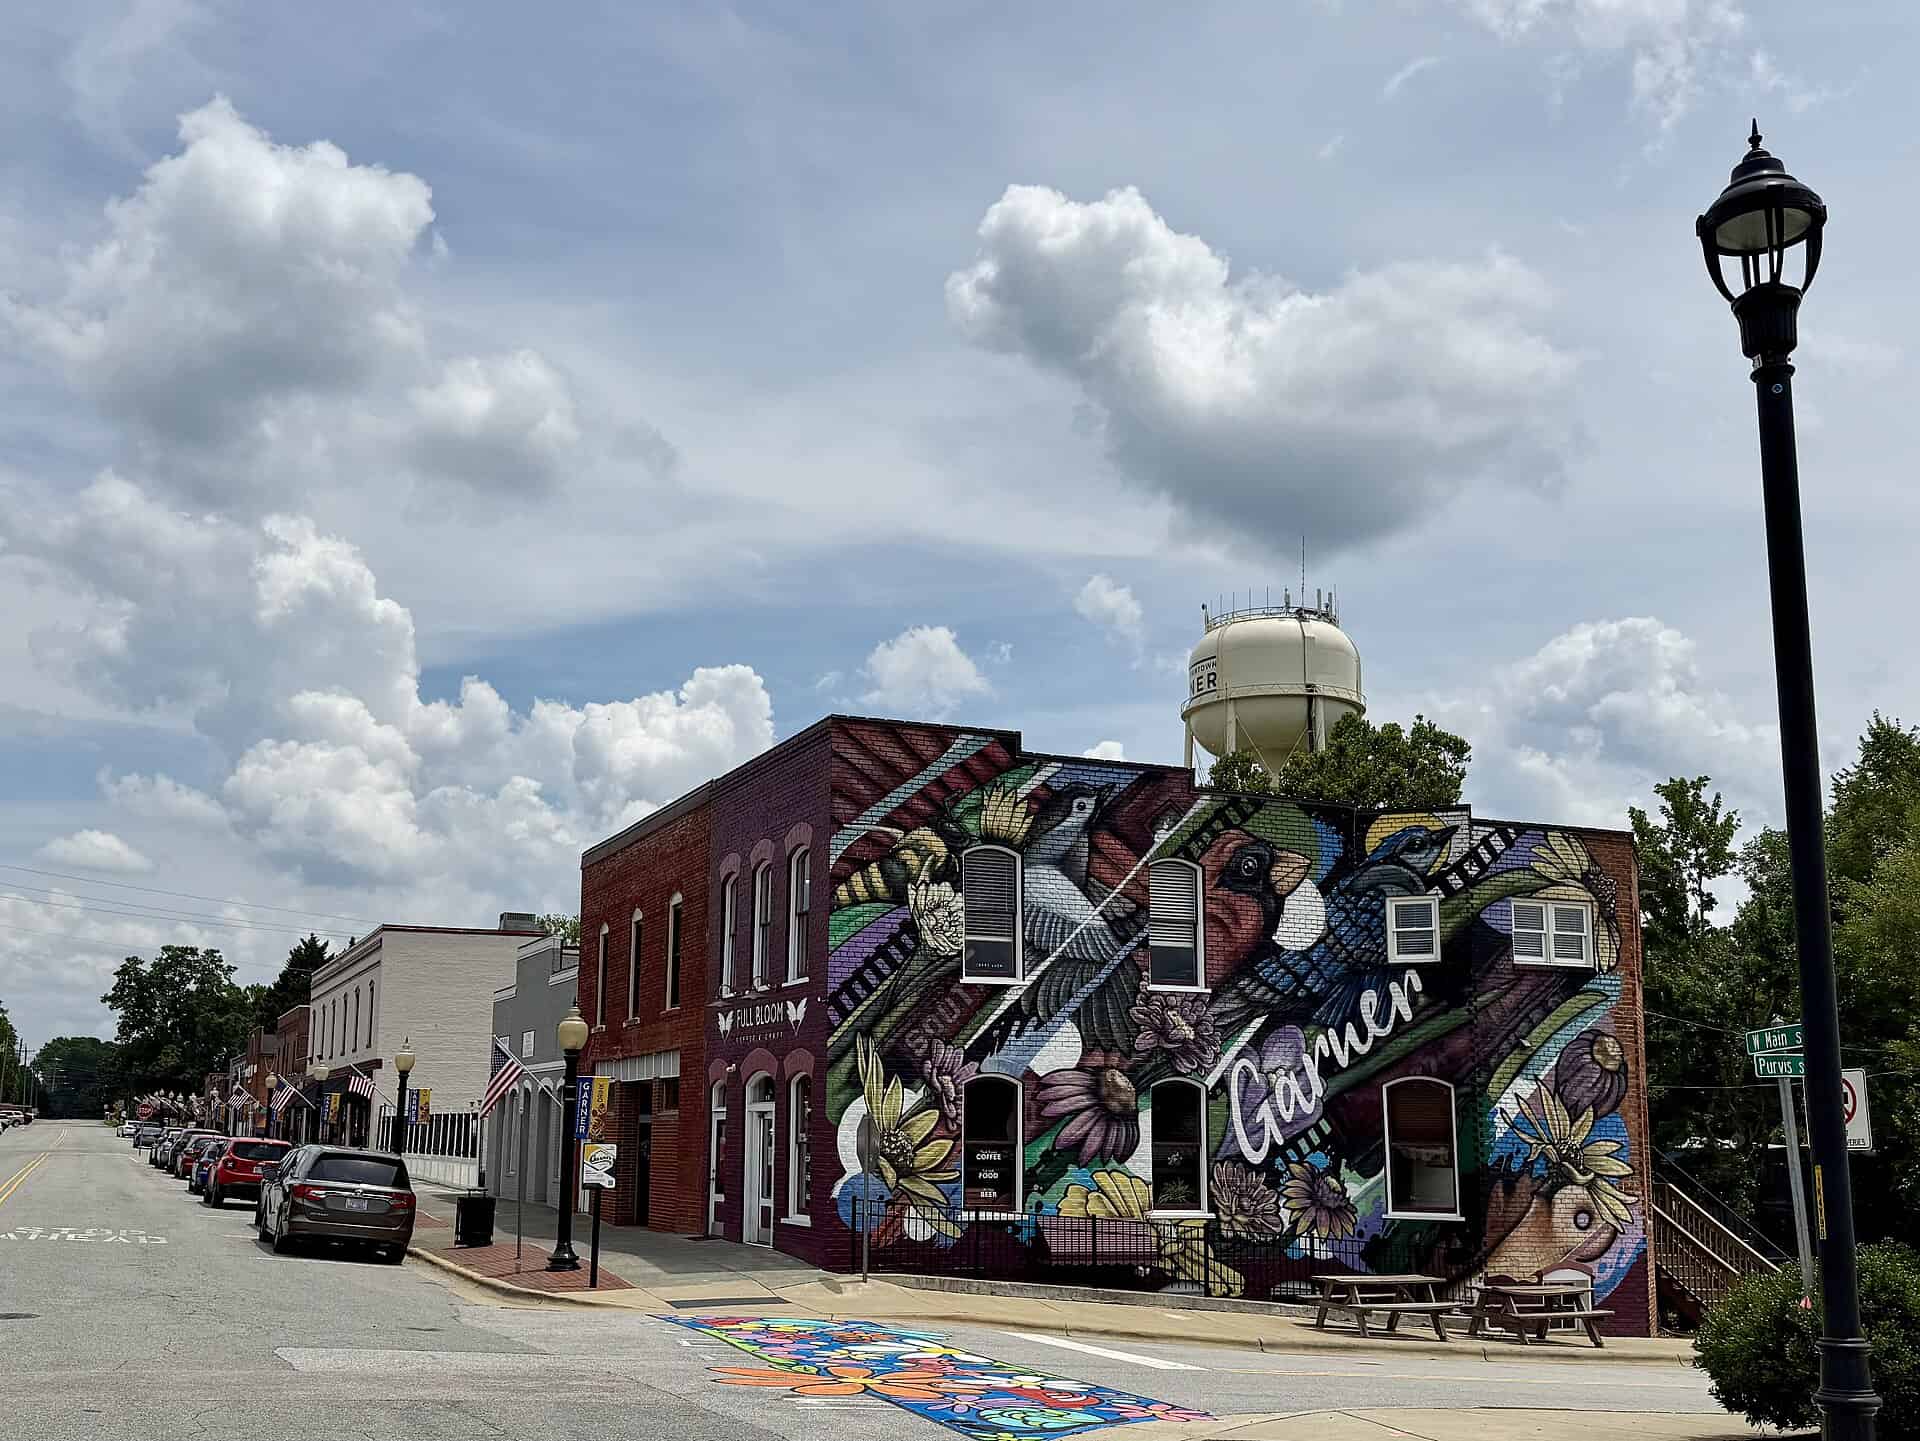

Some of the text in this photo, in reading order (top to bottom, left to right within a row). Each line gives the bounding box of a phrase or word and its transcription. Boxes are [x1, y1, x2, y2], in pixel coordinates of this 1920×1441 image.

[736, 1001, 784, 1029] FULL BLOOM
[1751, 1034, 1760, 1051] W
[1765, 1030, 1788, 1049] Main
[1230, 969, 1423, 1165] Garner
[1759, 1057, 1792, 1074] Purvis
[579, 1082, 591, 1134] GARNER
[976, 1153, 1002, 1161] COFFEE
[978, 1171, 999, 1179] FOOD
[980, 1191, 997, 1199] BEER
